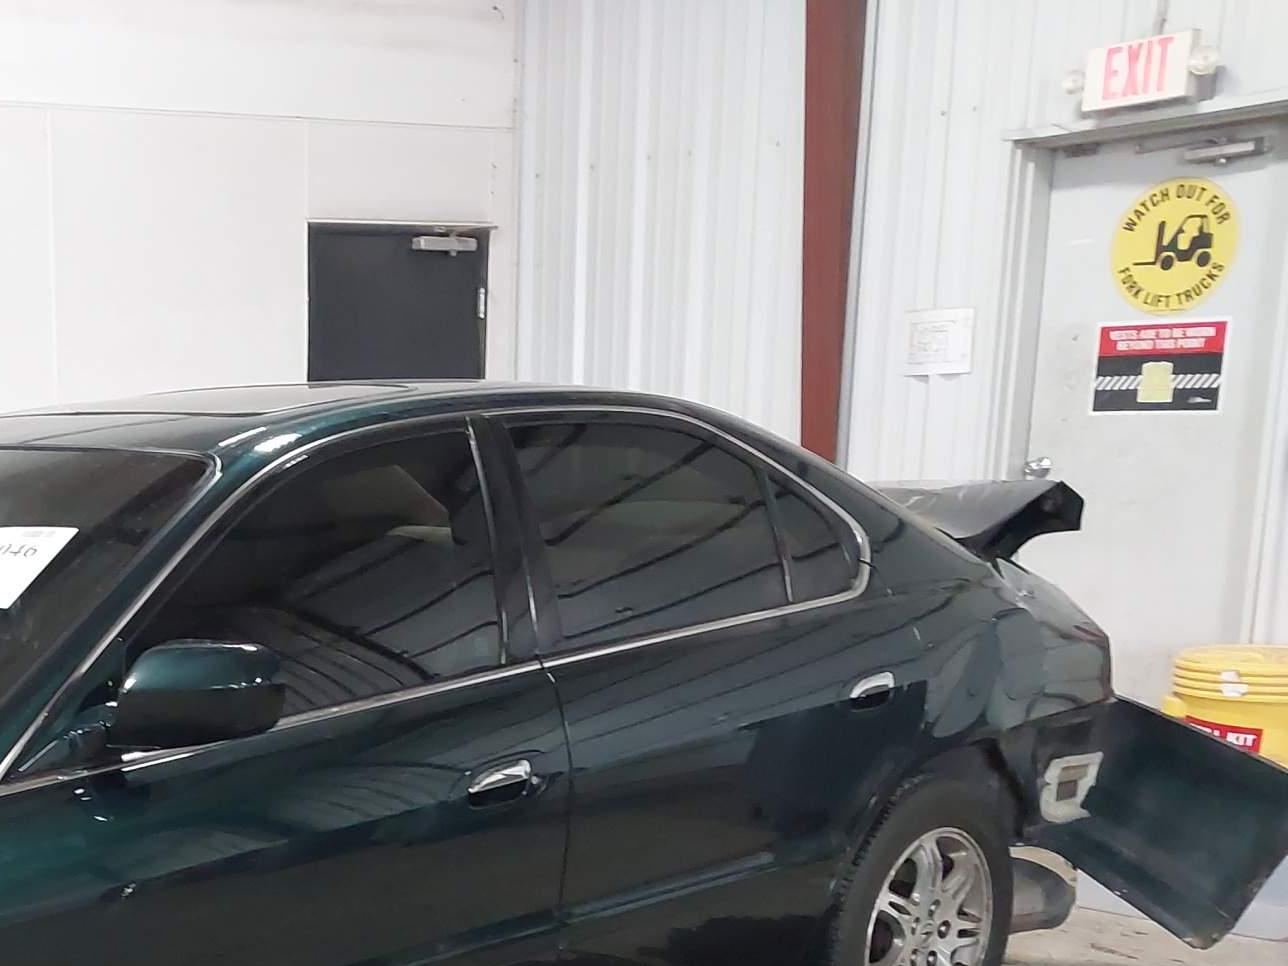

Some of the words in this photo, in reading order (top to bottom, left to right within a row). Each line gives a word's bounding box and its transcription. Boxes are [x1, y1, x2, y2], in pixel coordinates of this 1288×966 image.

[1102, 36, 1175, 100] EXIT
[1122, 187, 1170, 231] WATCH
[1176, 183, 1207, 201] OUT
[1205, 194, 1231, 225] FOR
[1117, 266, 1144, 298] FORK
[1143, 292, 1171, 307] LIFT
[1175, 261, 1225, 304] TRUCKS
[1226, 732, 1258, 747] KIT
